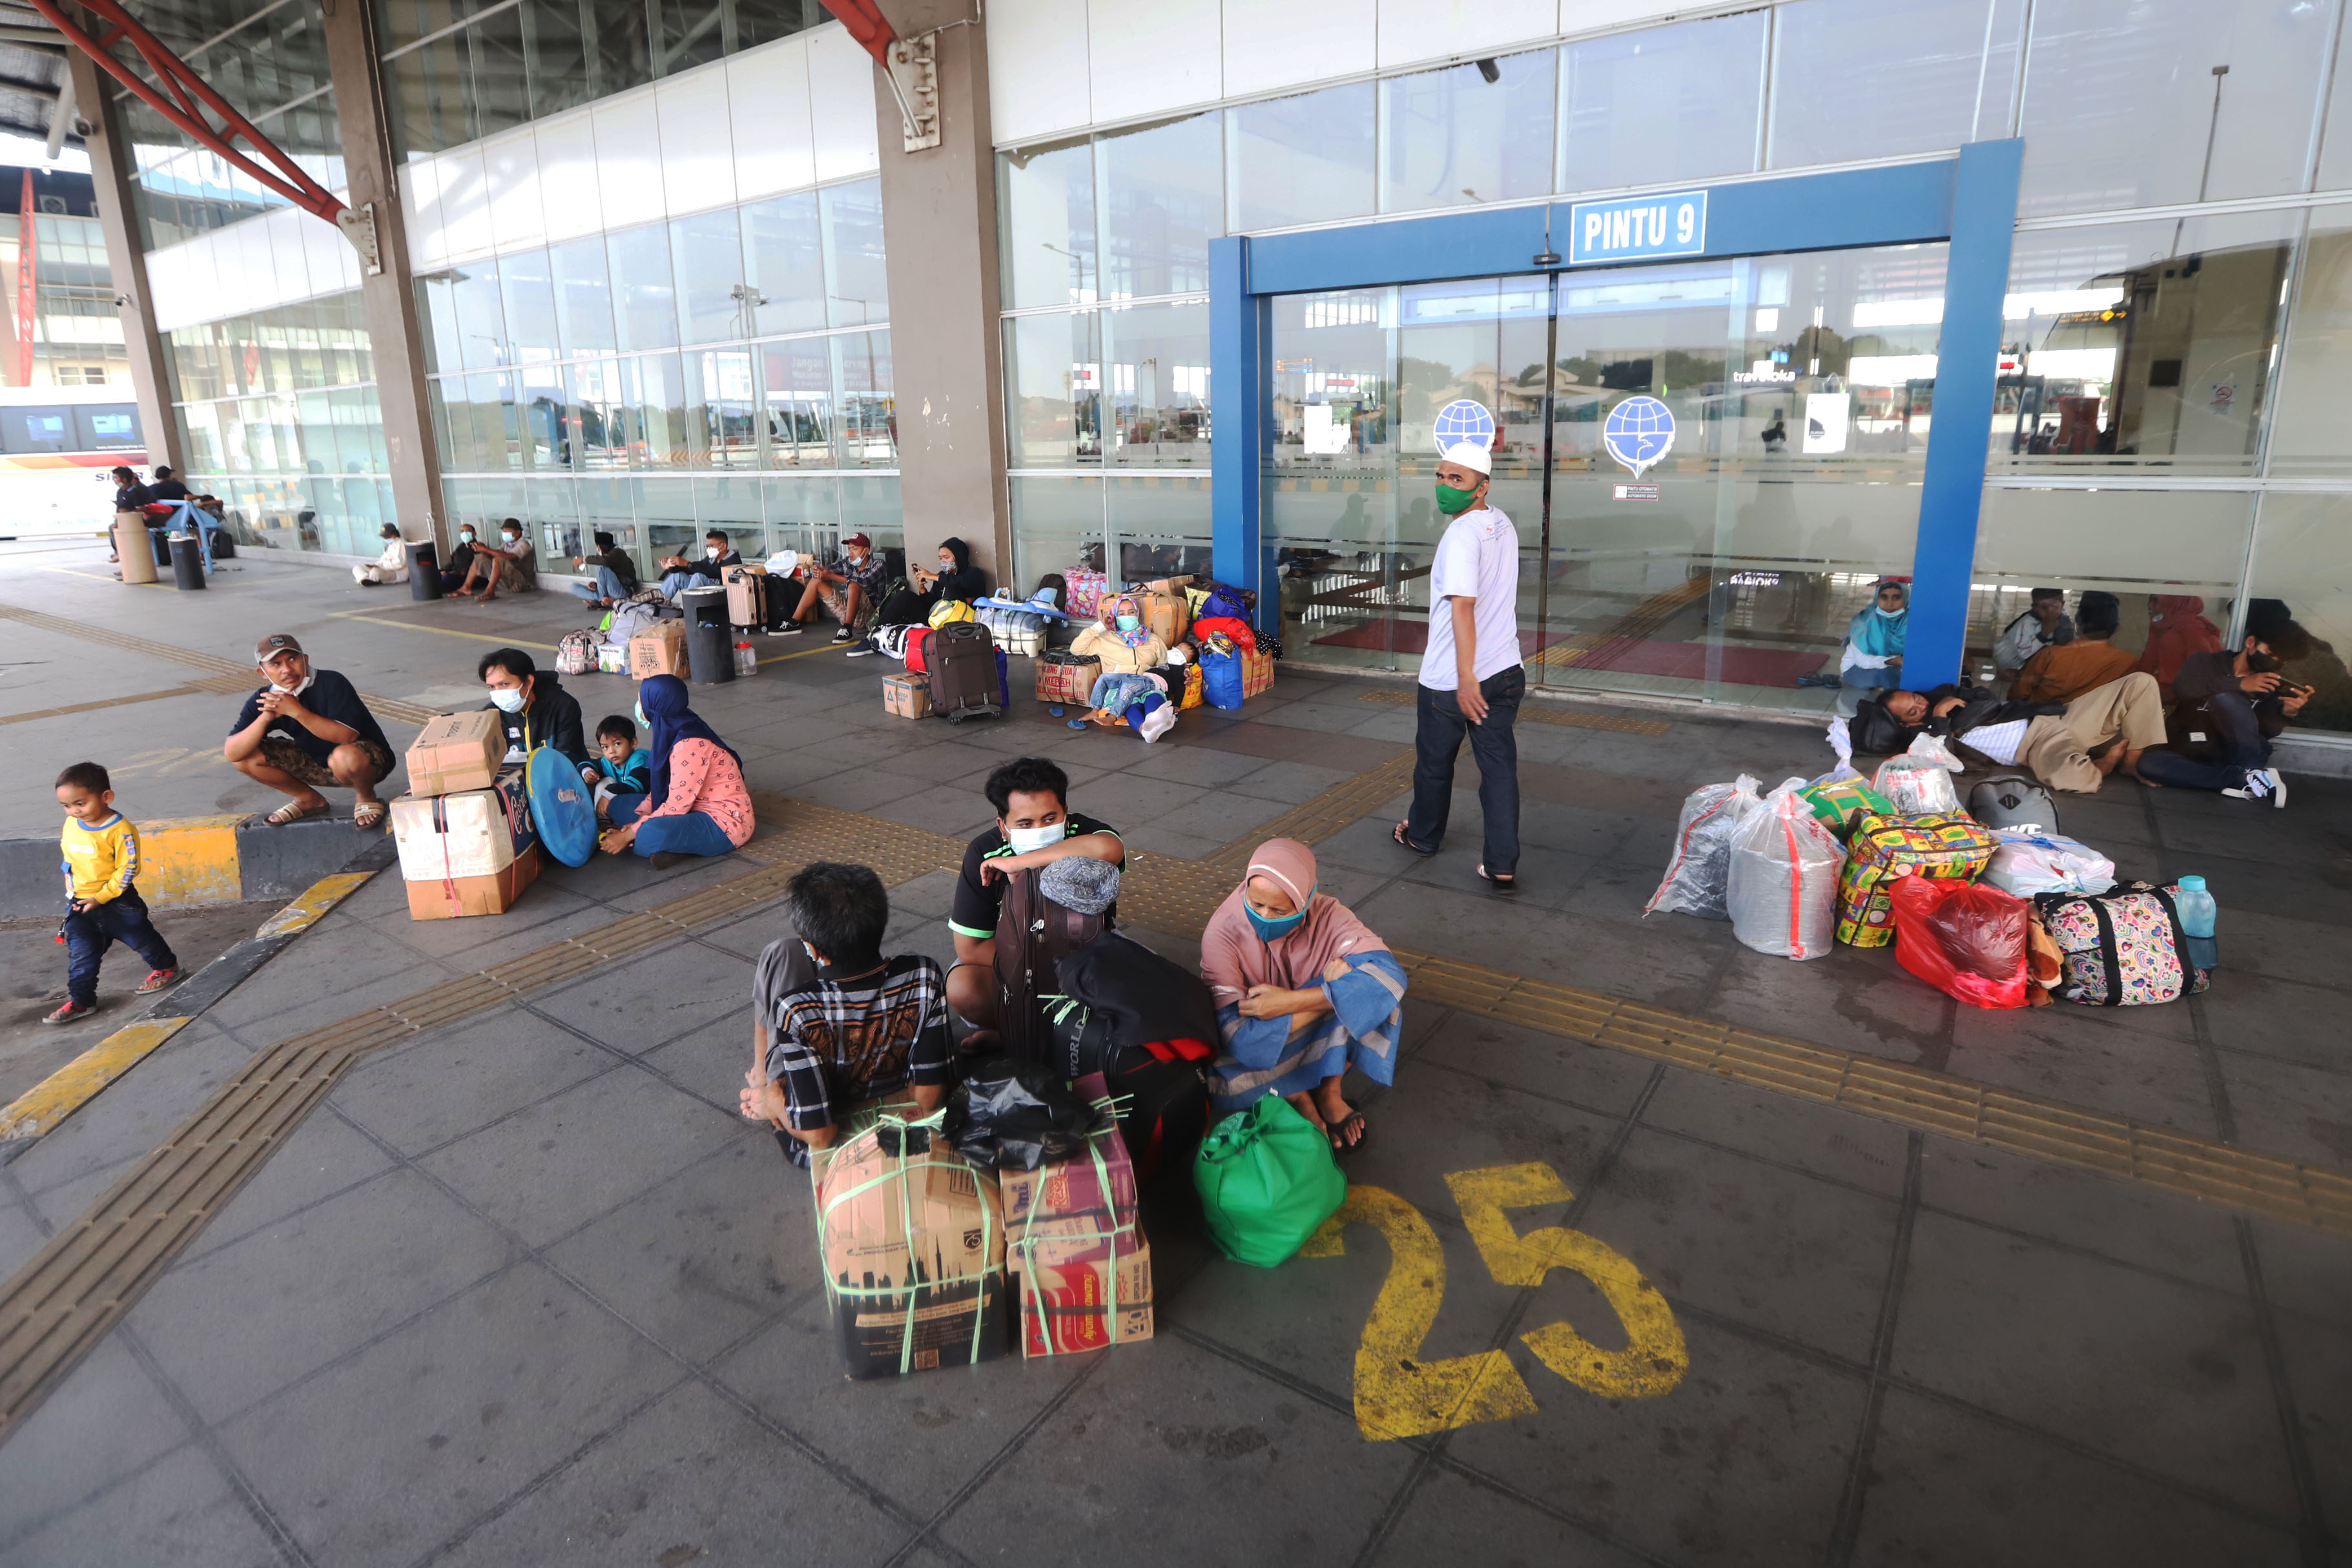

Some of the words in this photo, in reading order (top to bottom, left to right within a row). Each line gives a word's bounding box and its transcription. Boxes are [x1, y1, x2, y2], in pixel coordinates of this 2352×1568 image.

[1585, 206, 1667, 251] PINTU
[1677, 203, 1695, 243] 9
[1069, 1018, 1086, 1077] WORLD
[1084, 1274, 1095, 1308] awang
[1298, 1162, 1689, 1441] 25
